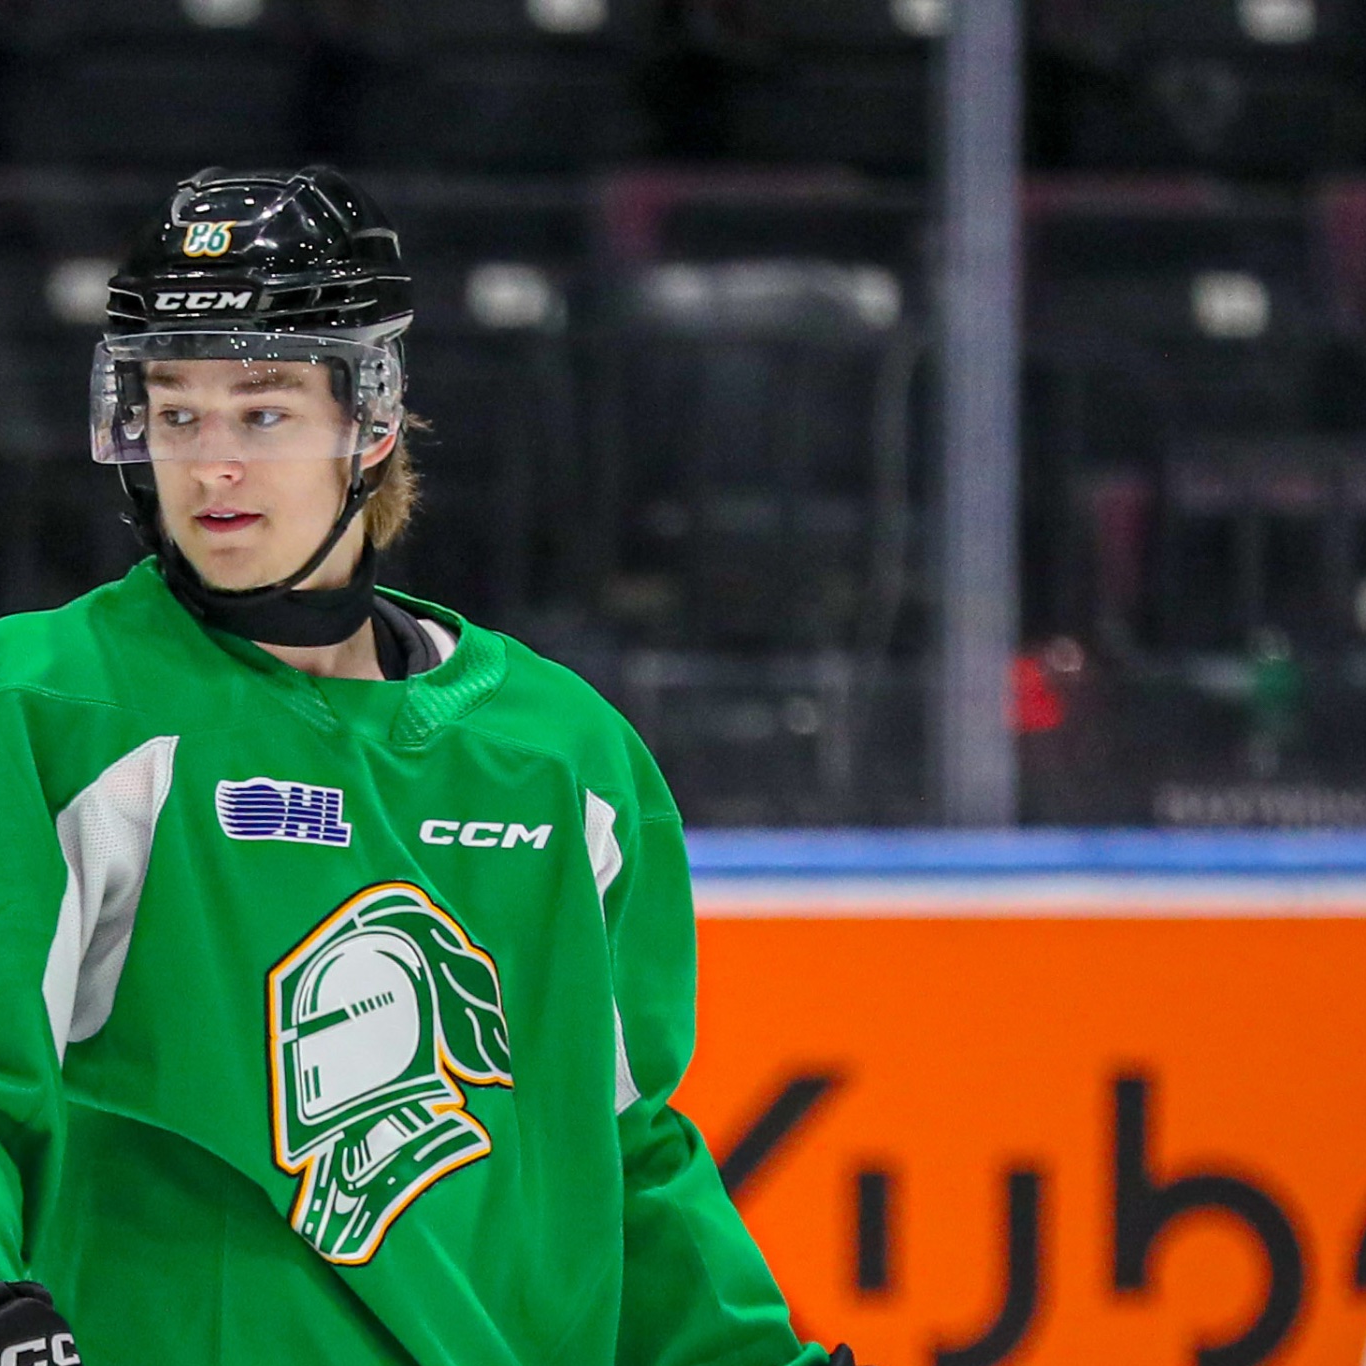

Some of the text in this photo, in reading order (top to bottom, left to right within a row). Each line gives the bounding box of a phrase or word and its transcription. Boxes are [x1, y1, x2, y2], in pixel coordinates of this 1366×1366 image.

[184, 221, 237, 257] 86
[154, 291, 253, 310] CCM
[217, 779, 350, 846] OHL
[419, 820, 553, 849] CCM
